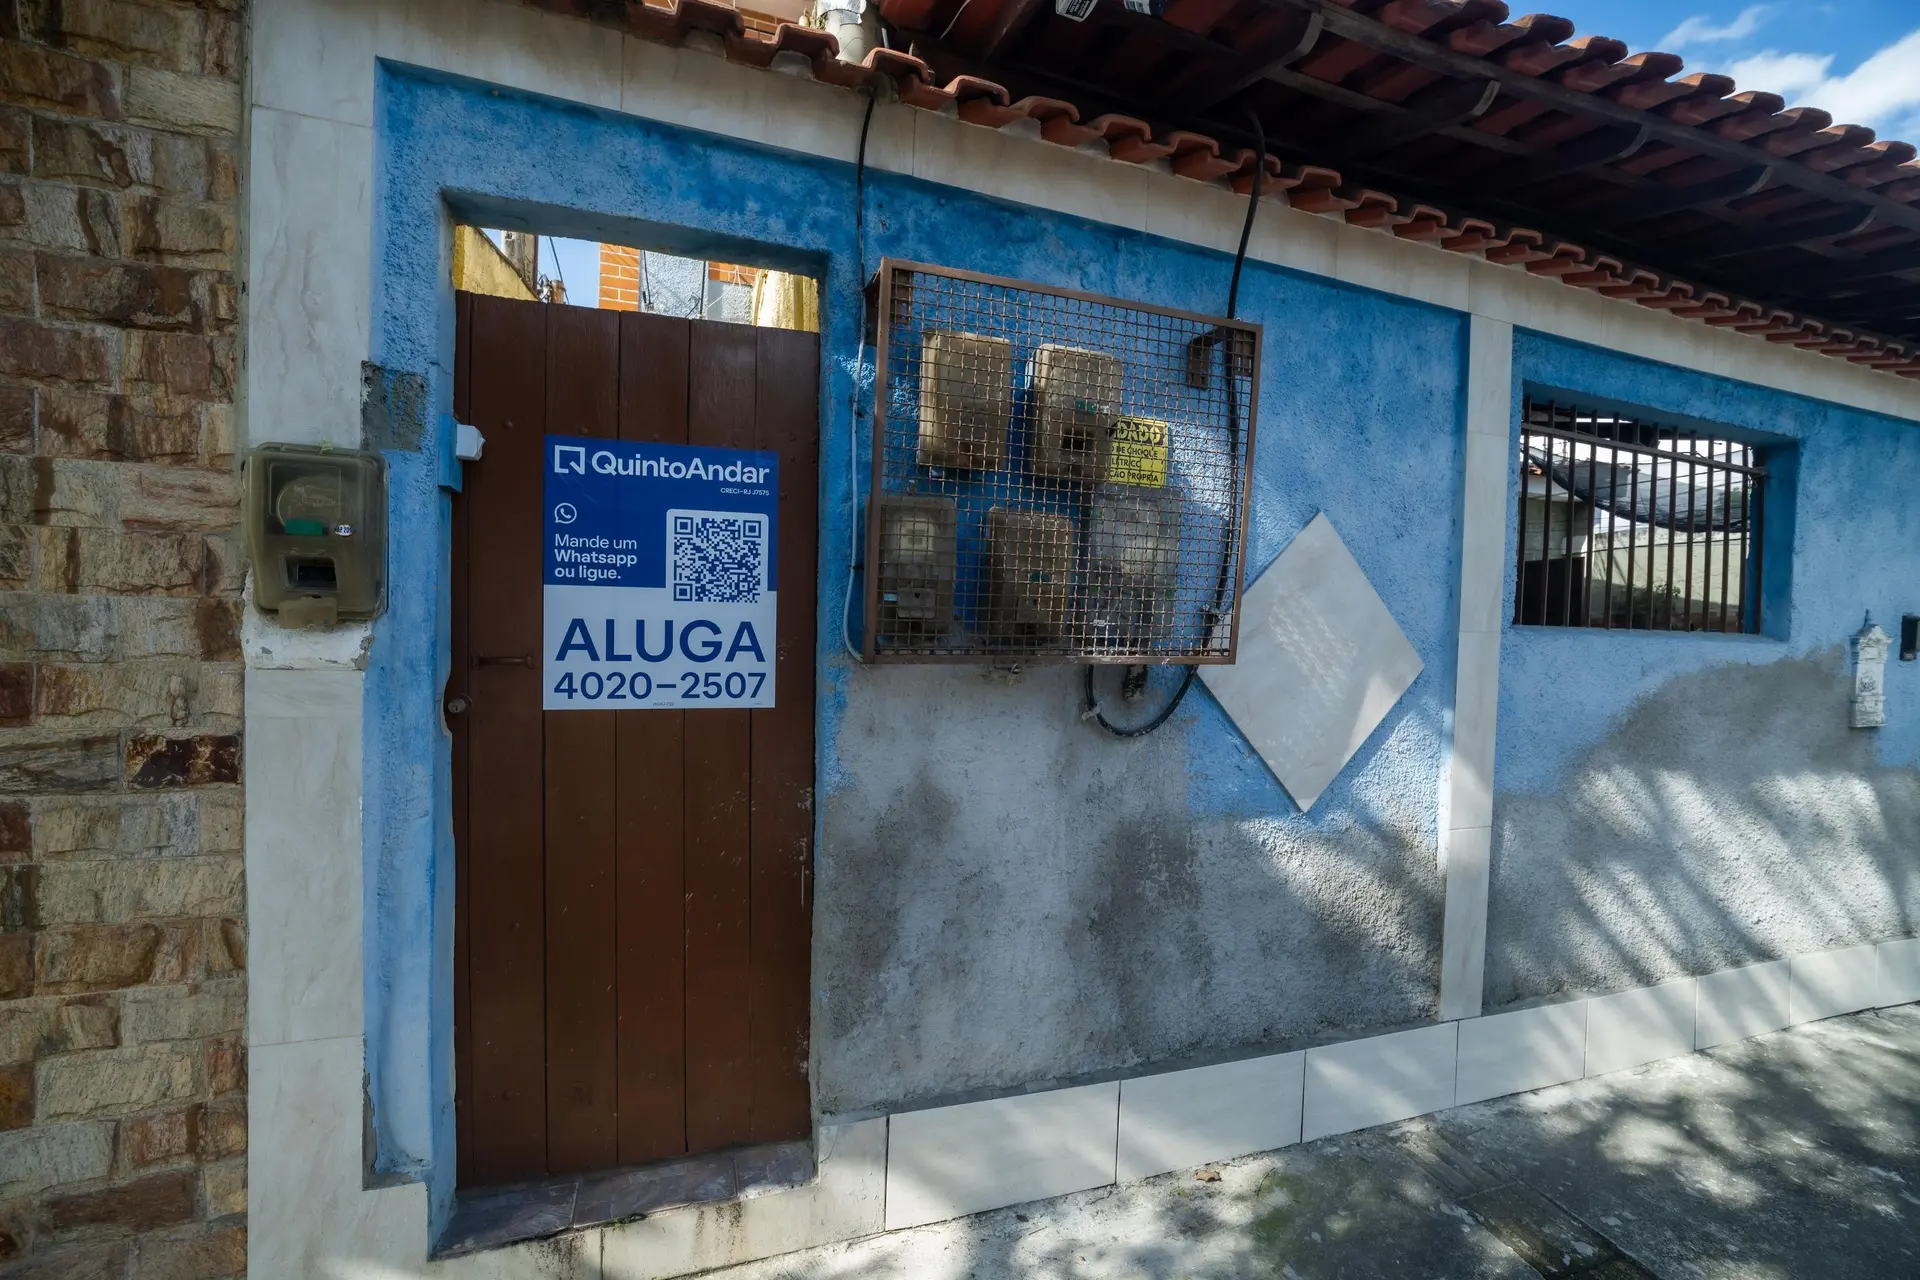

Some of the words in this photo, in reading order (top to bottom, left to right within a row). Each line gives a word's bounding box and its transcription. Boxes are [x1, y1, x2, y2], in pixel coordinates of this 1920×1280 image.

[591, 450, 770, 484] QuintoAndar
[555, 533, 609, 549] Mande
[613, 539, 637, 550] um
[554, 549, 638, 567] Whatsapp
[554, 567, 575, 578] ou
[579, 565, 621, 581] ligue.
[554, 617, 766, 663] ALUGA
[553, 671, 767, 700] 4020-2507
